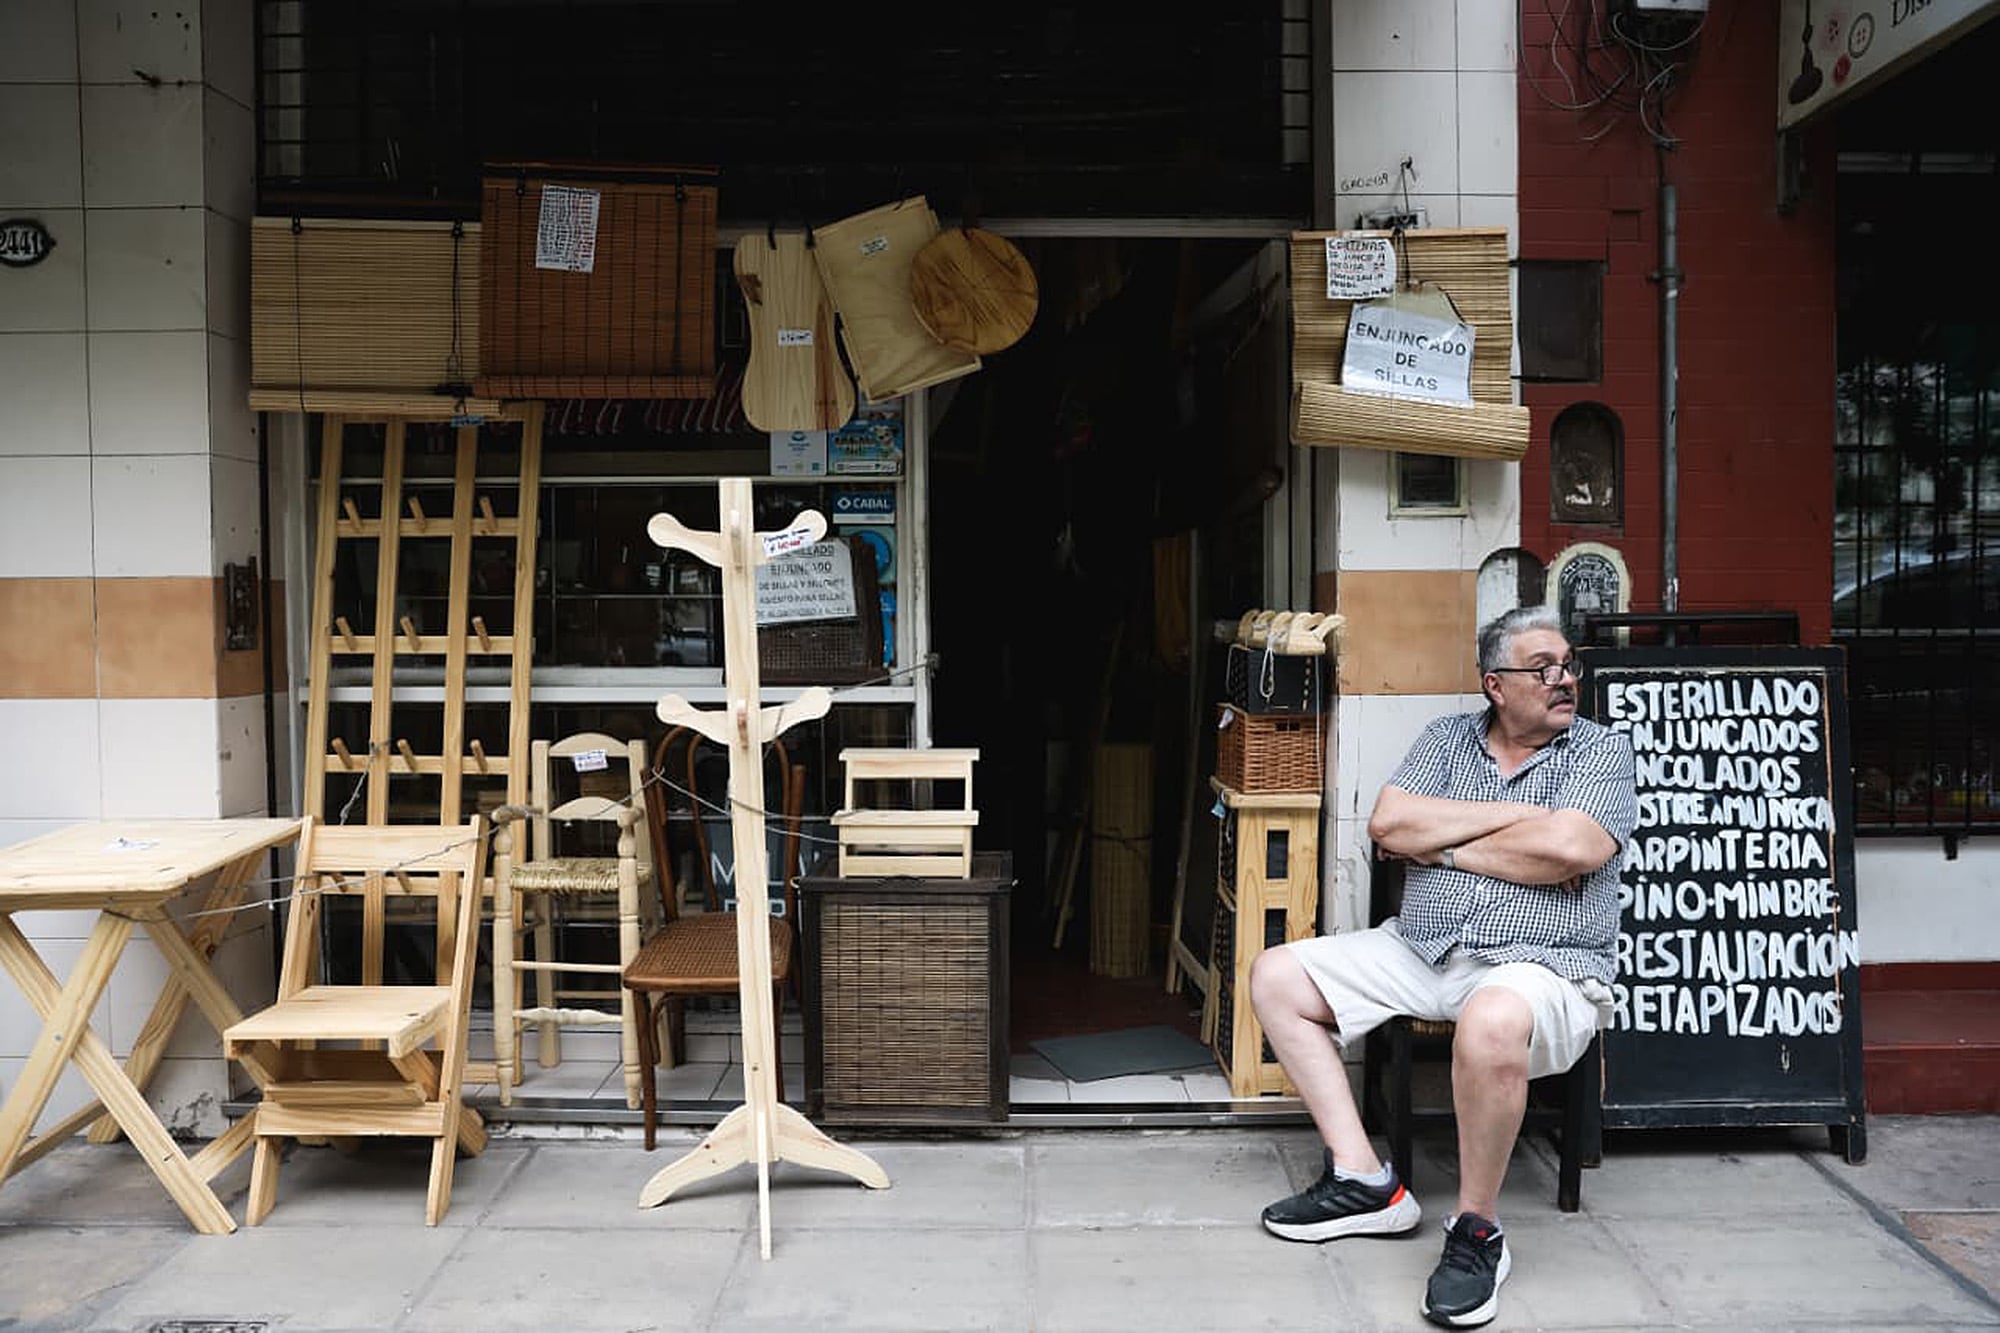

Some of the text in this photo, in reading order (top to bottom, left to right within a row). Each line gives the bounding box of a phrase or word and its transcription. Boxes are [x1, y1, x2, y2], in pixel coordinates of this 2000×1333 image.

[1355, 322, 1467, 357] ENJUNCADO
[1374, 367, 1439, 391] SILLAS
[1395, 352, 1418, 368] DE
[853, 498, 891, 509] CABAL
[1607, 678, 1820, 722] ESTERILLADO
[1635, 753, 1802, 792] NCOLADOS
[1634, 791, 1709, 830] STRE
[1622, 831, 1828, 873] ARPINTERIA
[1612, 983, 1843, 1037] RETAPIZADOS
